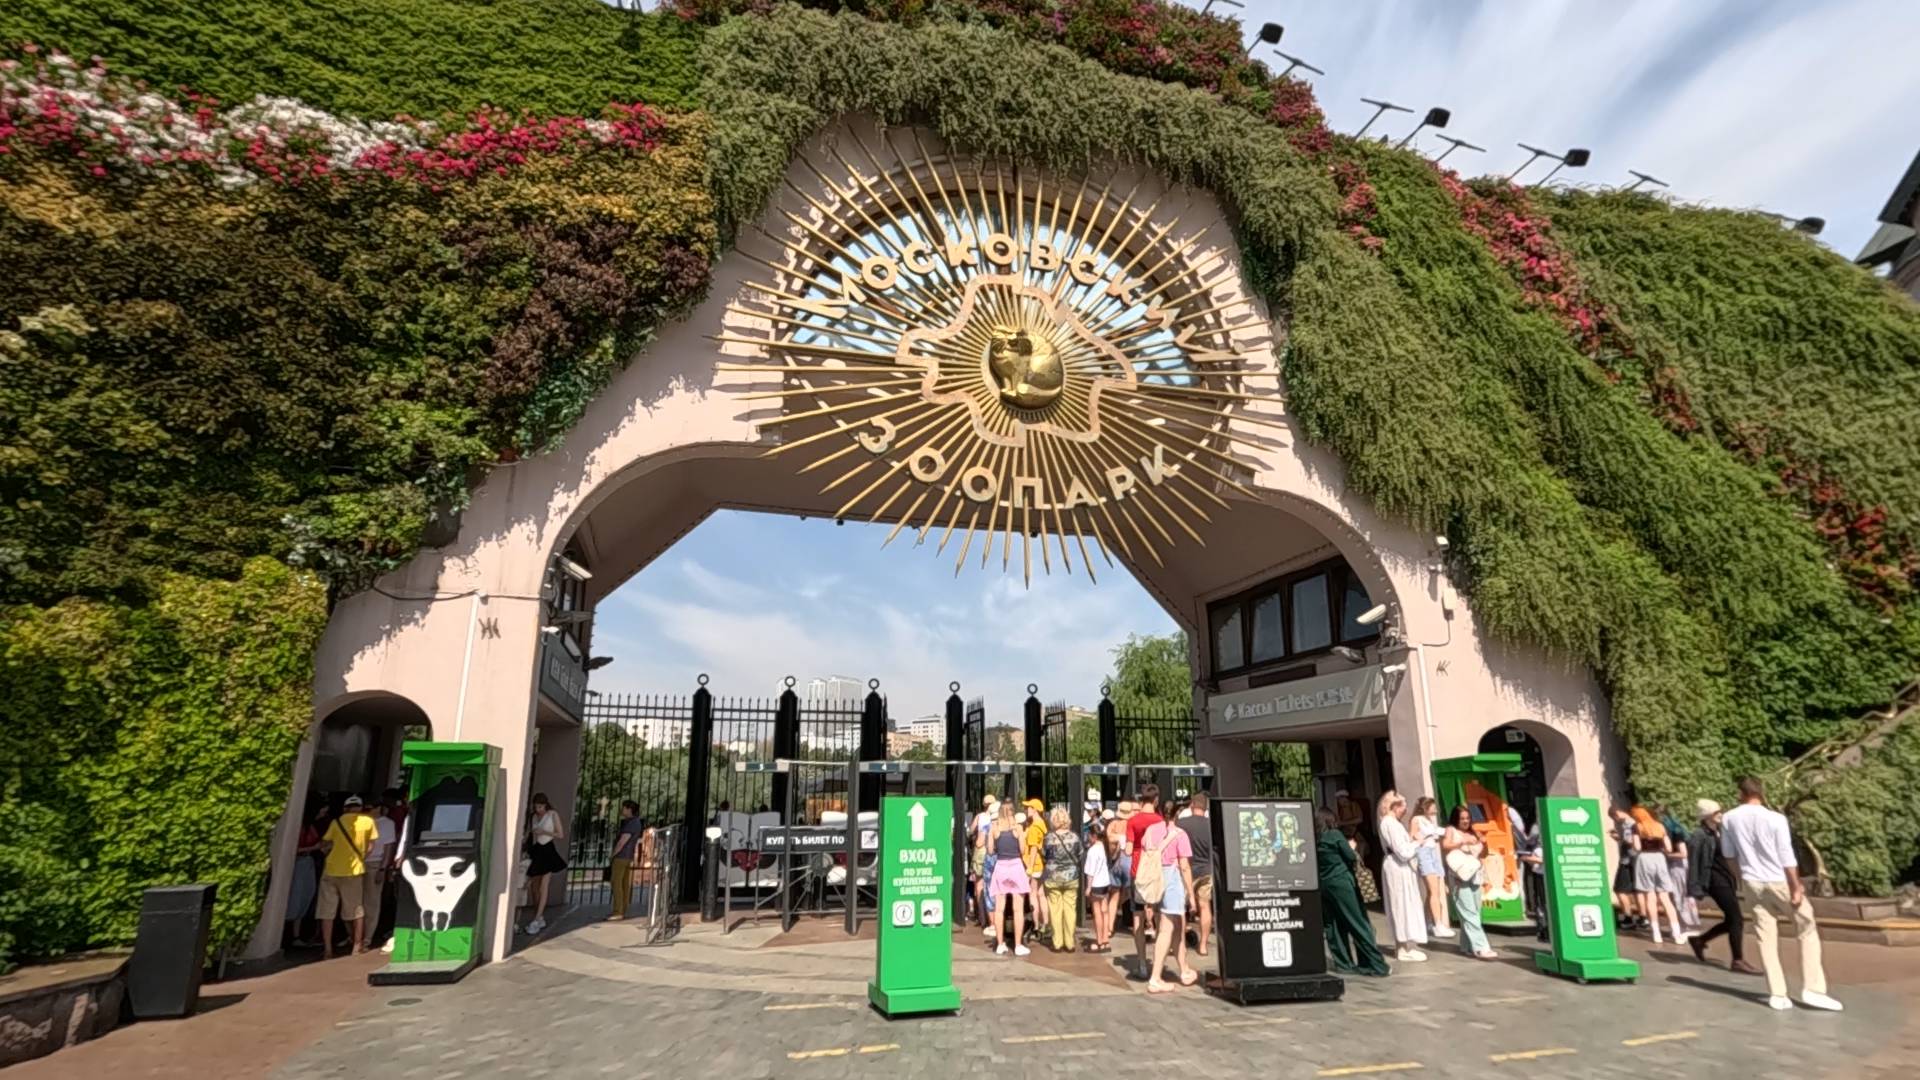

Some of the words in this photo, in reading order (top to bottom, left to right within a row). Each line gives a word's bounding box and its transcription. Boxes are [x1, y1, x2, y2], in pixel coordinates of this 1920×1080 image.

[770, 232, 1248, 363] МОСКОВСКИЙ
[858, 416, 1180, 511] ЗООПАРК
[766, 836, 801, 845] КУПТЬ
[802, 835, 830, 845] БИЛЕТ
[832, 835, 845, 845] ПО
[899, 848, 937, 865] ВХОД
[903, 868, 915, 876] ПО
[1248, 907, 1289, 922] ВХОДЫ
